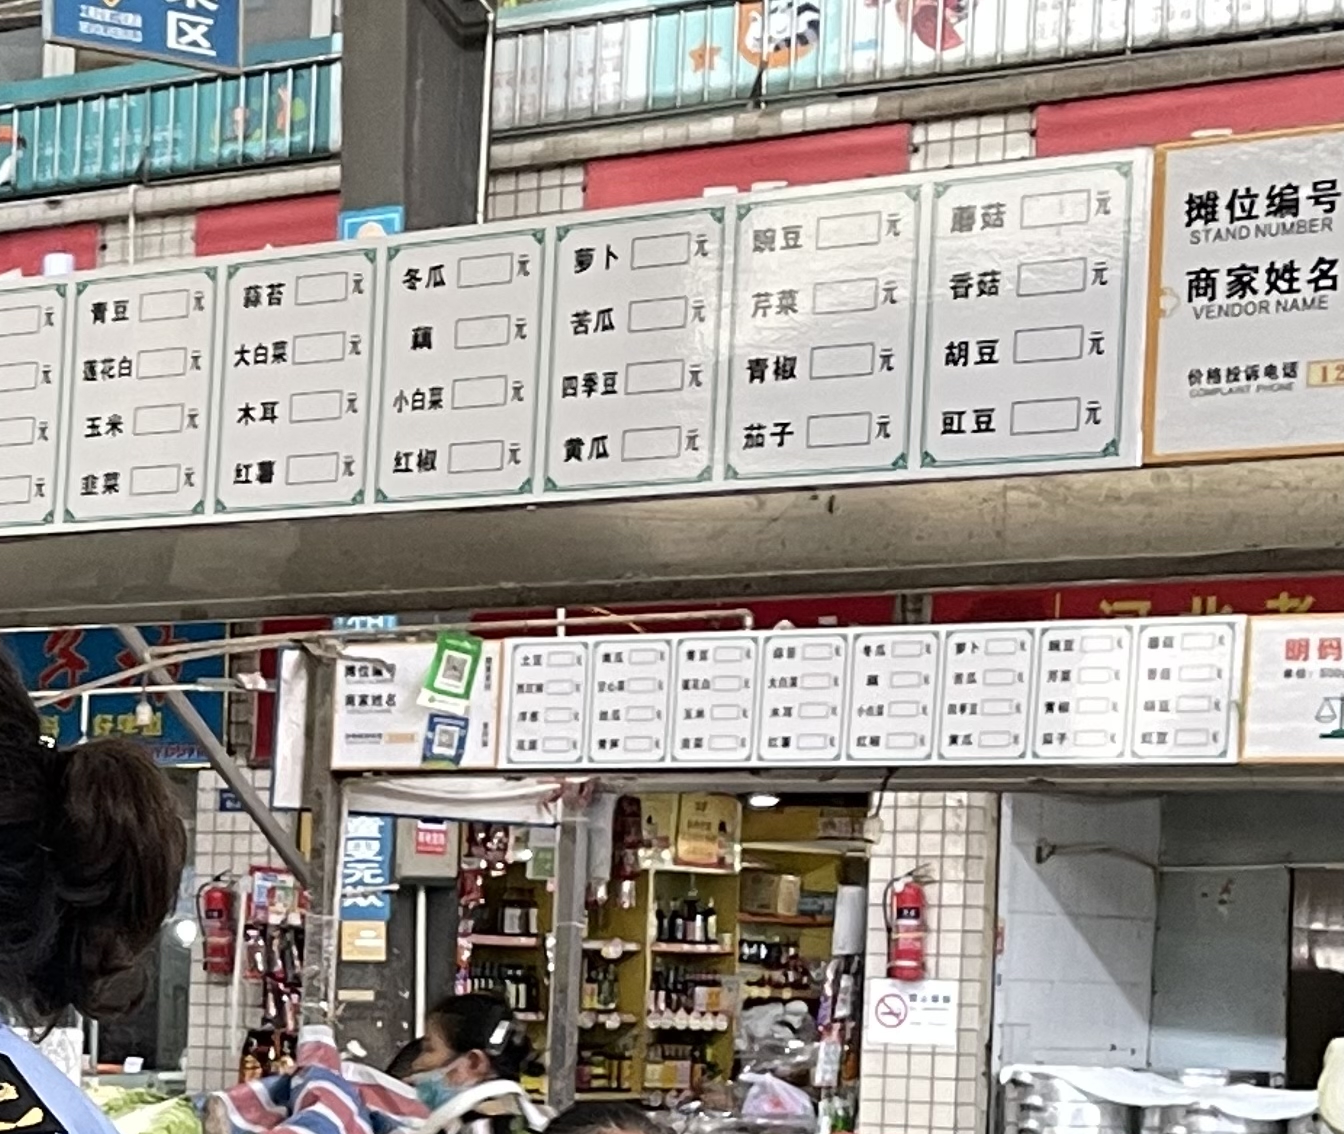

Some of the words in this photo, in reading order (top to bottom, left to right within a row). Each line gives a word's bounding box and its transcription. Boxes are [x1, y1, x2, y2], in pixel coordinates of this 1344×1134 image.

[950, 203, 1006, 233] 蘑菇
[1095, 190, 1111, 216] 元
[1184, 178, 1341, 227] 摊位编号
[752, 225, 803, 253] 豌豆
[886, 213, 901, 236] 元
[1189, 224, 1250, 245] STAND
[1254, 217, 1333, 237] NUMBER
[574, 246, 618, 273] 萝卜
[694, 234, 709, 257] 元
[352, 273, 364, 293] 元
[402, 264, 446, 291] 冬瓜
[517, 254, 529, 276] 元
[949, 271, 1002, 299] 香菇
[1091, 262, 1108, 285] 元
[1186, 257, 1339, 303] 商家姓名
[92, 301, 130, 325] 青豆
[193, 292, 204, 312] 元
[752, 289, 799, 317] 芹菜
[882, 281, 897, 304] 元
[1193, 300, 1270, 320] VENDOR
[1275, 295, 1329, 314] NAME
[44, 306, 54, 327] 元
[515, 318, 526, 339] 元
[571, 308, 616, 335] 苦瓜
[691, 300, 705, 323] 元
[190, 350, 202, 371] 元
[234, 340, 288, 367] 大白菜
[349, 335, 361, 355] 元
[944, 339, 1000, 366] 胡豆
[1088, 331, 1105, 355] 元
[41, 364, 52, 385] 元
[562, 371, 618, 398] 四季豆
[689, 365, 703, 387] 元
[747, 356, 798, 383] 青椒
[879, 348, 894, 371] 元
[1188, 361, 1298, 387] 价格投诉电话
[237, 401, 279, 425] 木耳
[346, 392, 358, 413] 元
[393, 387, 444, 413] 小白菜
[512, 380, 523, 401] 元
[38, 422, 49, 441] 元
[84, 414, 123, 437] 玉米
[187, 408, 199, 429] 元
[743, 422, 794, 449] 茄子
[875, 416, 890, 439] 元
[941, 408, 996, 435] 豇豆
[1085, 401, 1102, 424] 元
[393, 448, 437, 474] 红椒
[509, 443, 521, 465] 元
[563, 435, 609, 462] 黄瓜
[685, 429, 699, 451] 元
[81, 472, 120, 496] 韭菜
[183, 468, 194, 488] 元
[233, 461, 275, 485] 红薯
[343, 456, 354, 476] 元
[35, 479, 45, 497] 元
